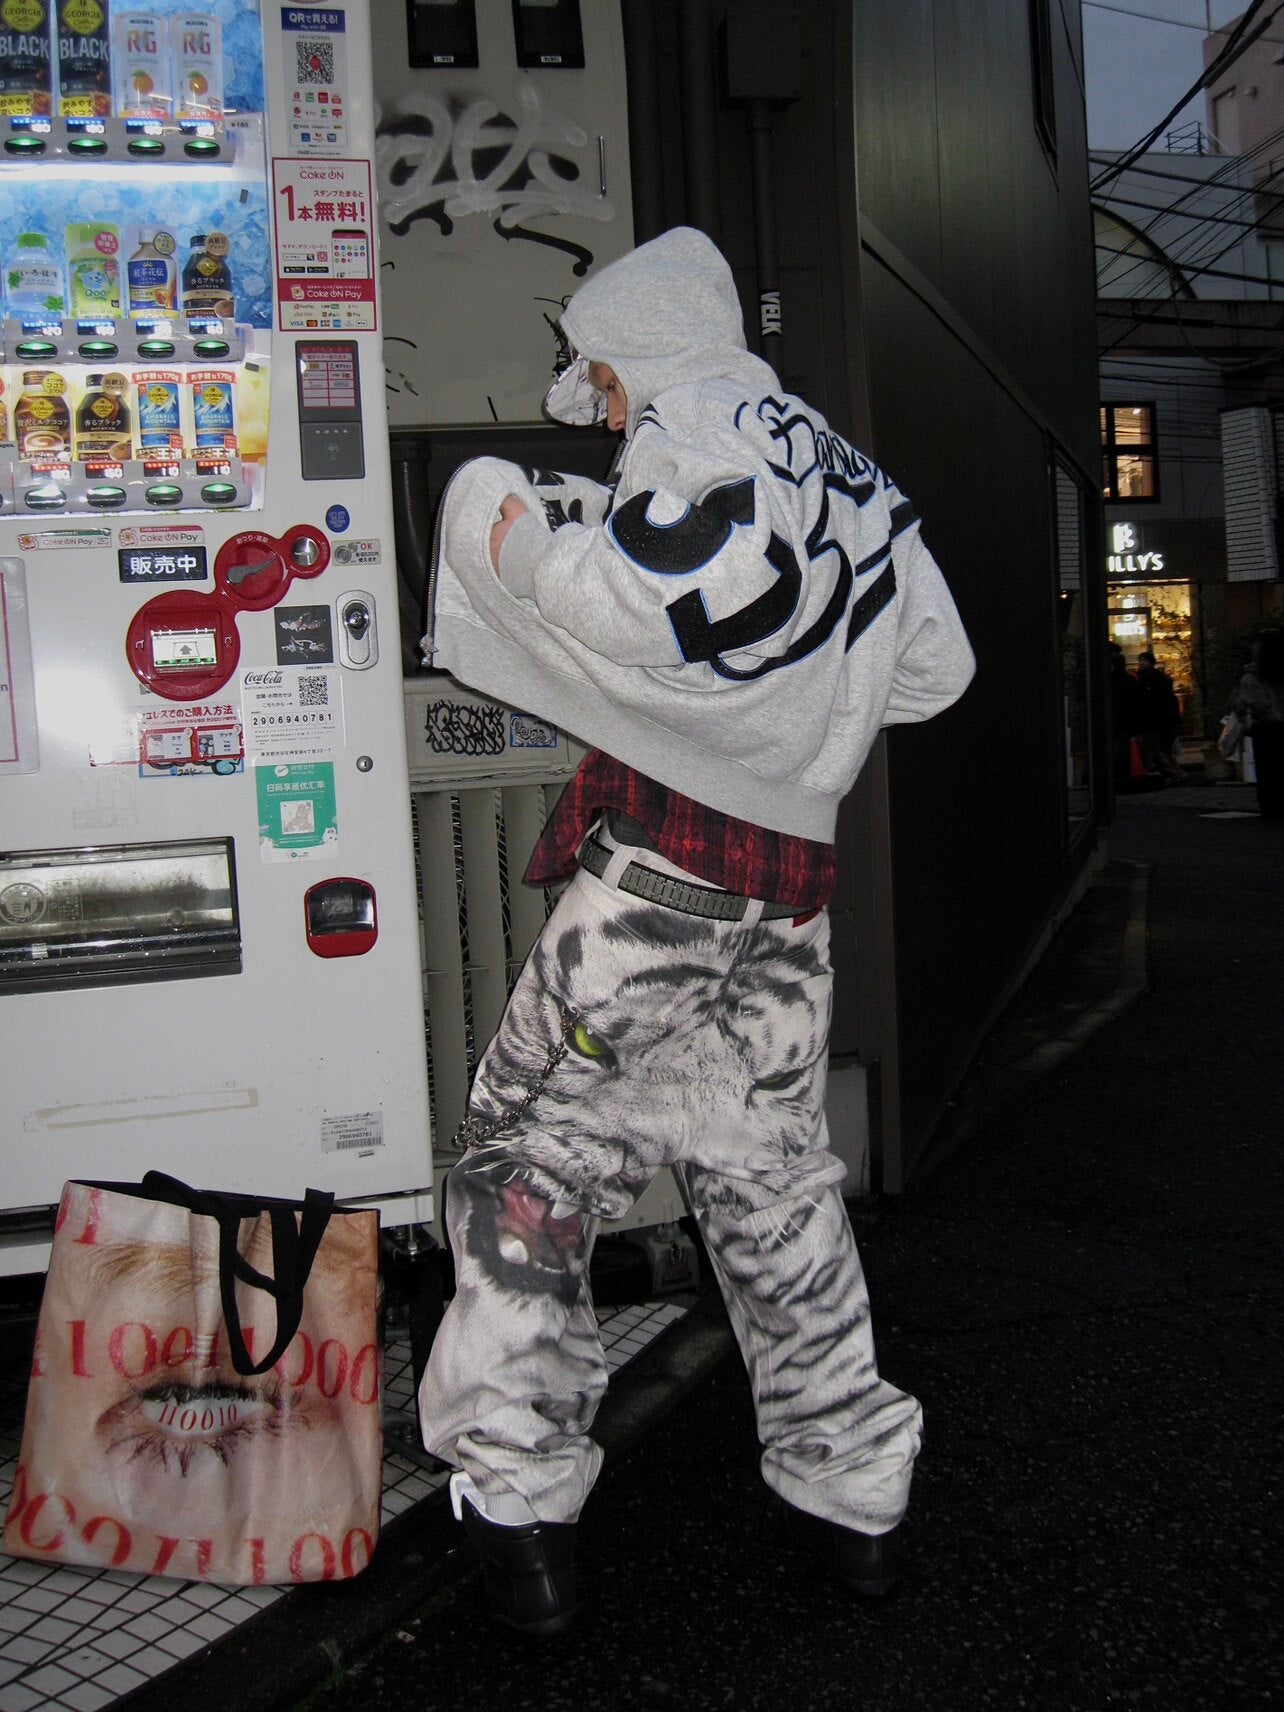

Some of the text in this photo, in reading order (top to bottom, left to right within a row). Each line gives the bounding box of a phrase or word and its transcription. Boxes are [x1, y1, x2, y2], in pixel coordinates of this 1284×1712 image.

[4, 8, 42, 17] GEORGIA
[66, 11, 102, 21] GEORGIA
[0, 35, 50, 60] BLACK
[59, 38, 110, 62] BLACK
[299, 170, 327, 181] Coke
[313, 189, 365, 199] スタンプたまると
[84, 288, 108, 298] Qoo
[306, 289, 329, 299] Coke
[345, 290, 363, 301] Pay
[139, 533, 164, 546] Coke
[180, 531, 198, 546] Pay
[360, 543, 374, 551] OK
[130, 554, 198, 576] 販売中
